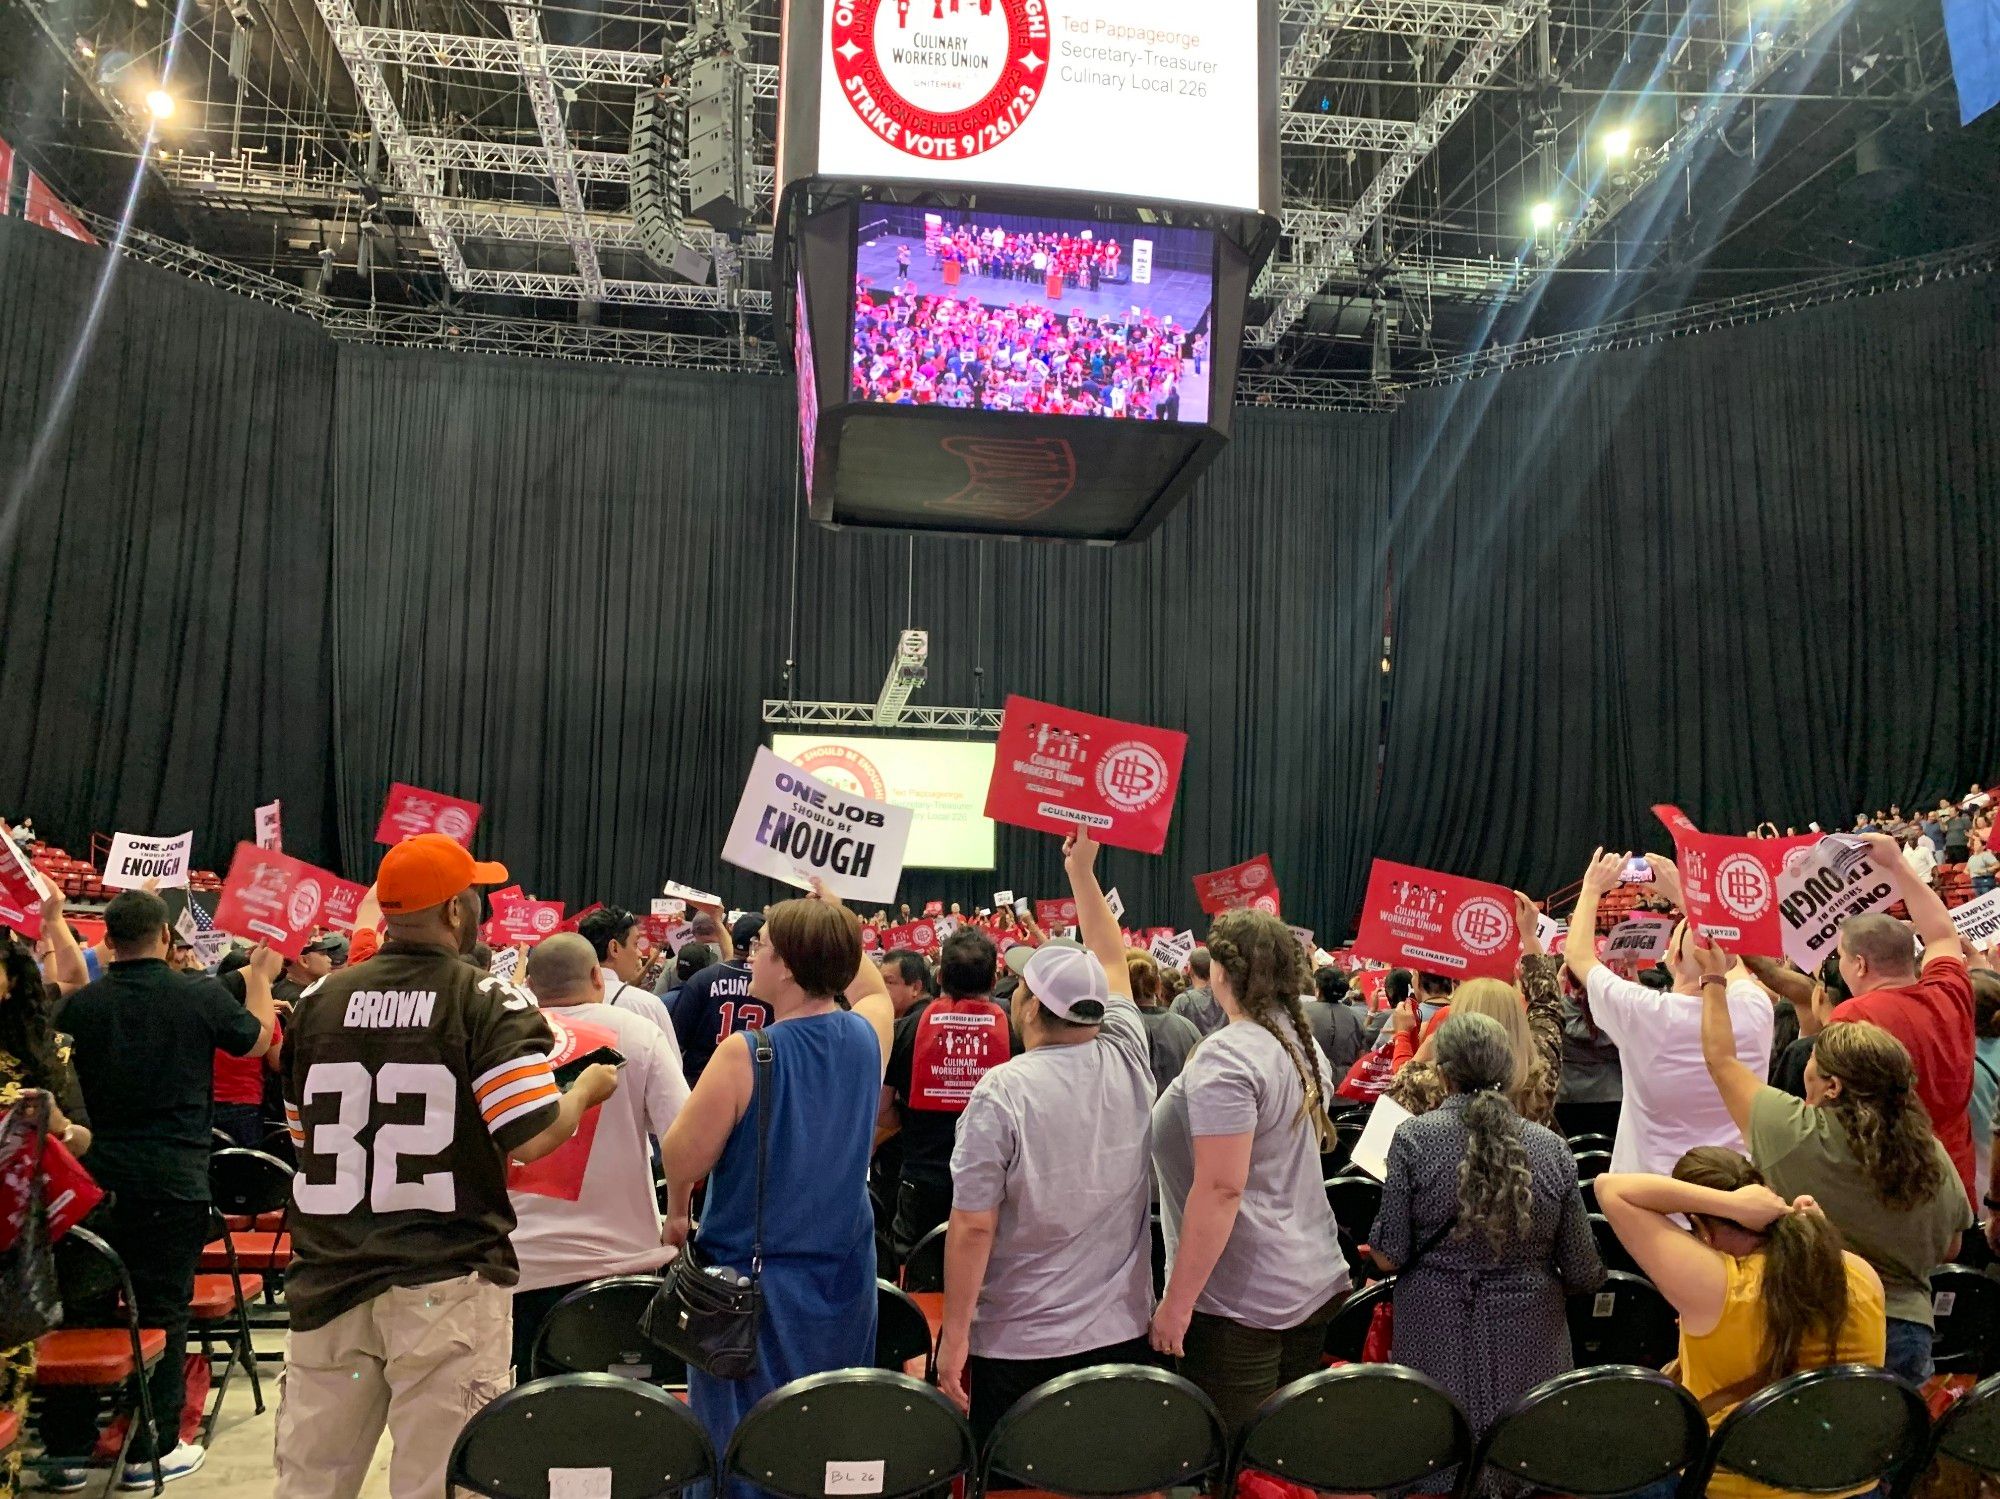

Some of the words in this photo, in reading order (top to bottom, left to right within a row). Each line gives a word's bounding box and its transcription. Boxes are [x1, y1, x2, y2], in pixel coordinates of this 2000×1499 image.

[913, 32, 968, 51] CULINARY
[1061, 15, 1089, 33] Ted
[1096, 19, 1200, 50] Pappageorge
[892, 48, 947, 67] WORKERS
[952, 53, 989, 69] UNION
[1061, 40, 1218, 74] Secretary-Treasurer
[1060, 65, 1126, 91] Culinary
[1132, 73, 1173, 93] Local
[1179, 79, 1207, 98] 226
[845, 75, 901, 142] STRIKE
[904, 130, 957, 157] VOTE
[961, 85, 1036, 154] 9/26/23
[803, 746, 845, 761] SHOULD
[775, 772, 827, 811] ONE
[828, 800, 885, 828] JOB
[791, 801, 835, 828] SHOULD
[837, 822, 853, 834] BE
[128, 841, 160, 852] ONE
[161, 840, 185, 852] JOB
[755, 804, 875, 879] ENOUGH
[121, 857, 181, 877] ENOUGH
[1828, 886, 1863, 914] SHOULD
[1848, 882, 1892, 916] ONE
[1961, 900, 1995, 919] EMPLEO
[1380, 910, 1415, 927] WORKERS
[1417, 919, 1442, 934] UNION
[1394, 905, 1431, 921] CULINARY
[1610, 934, 1658, 951] ENOUGH
[1152, 947, 1179, 968] ENOUGH
[710, 975, 750, 997] ACUÑ
[343, 990, 437, 1028] BROWN
[716, 1001, 767, 1045] 13
[931, 1065, 964, 1076] WORKERS
[943, 1056, 978, 1068] CULINARY
[292, 1061, 457, 1215] 32
